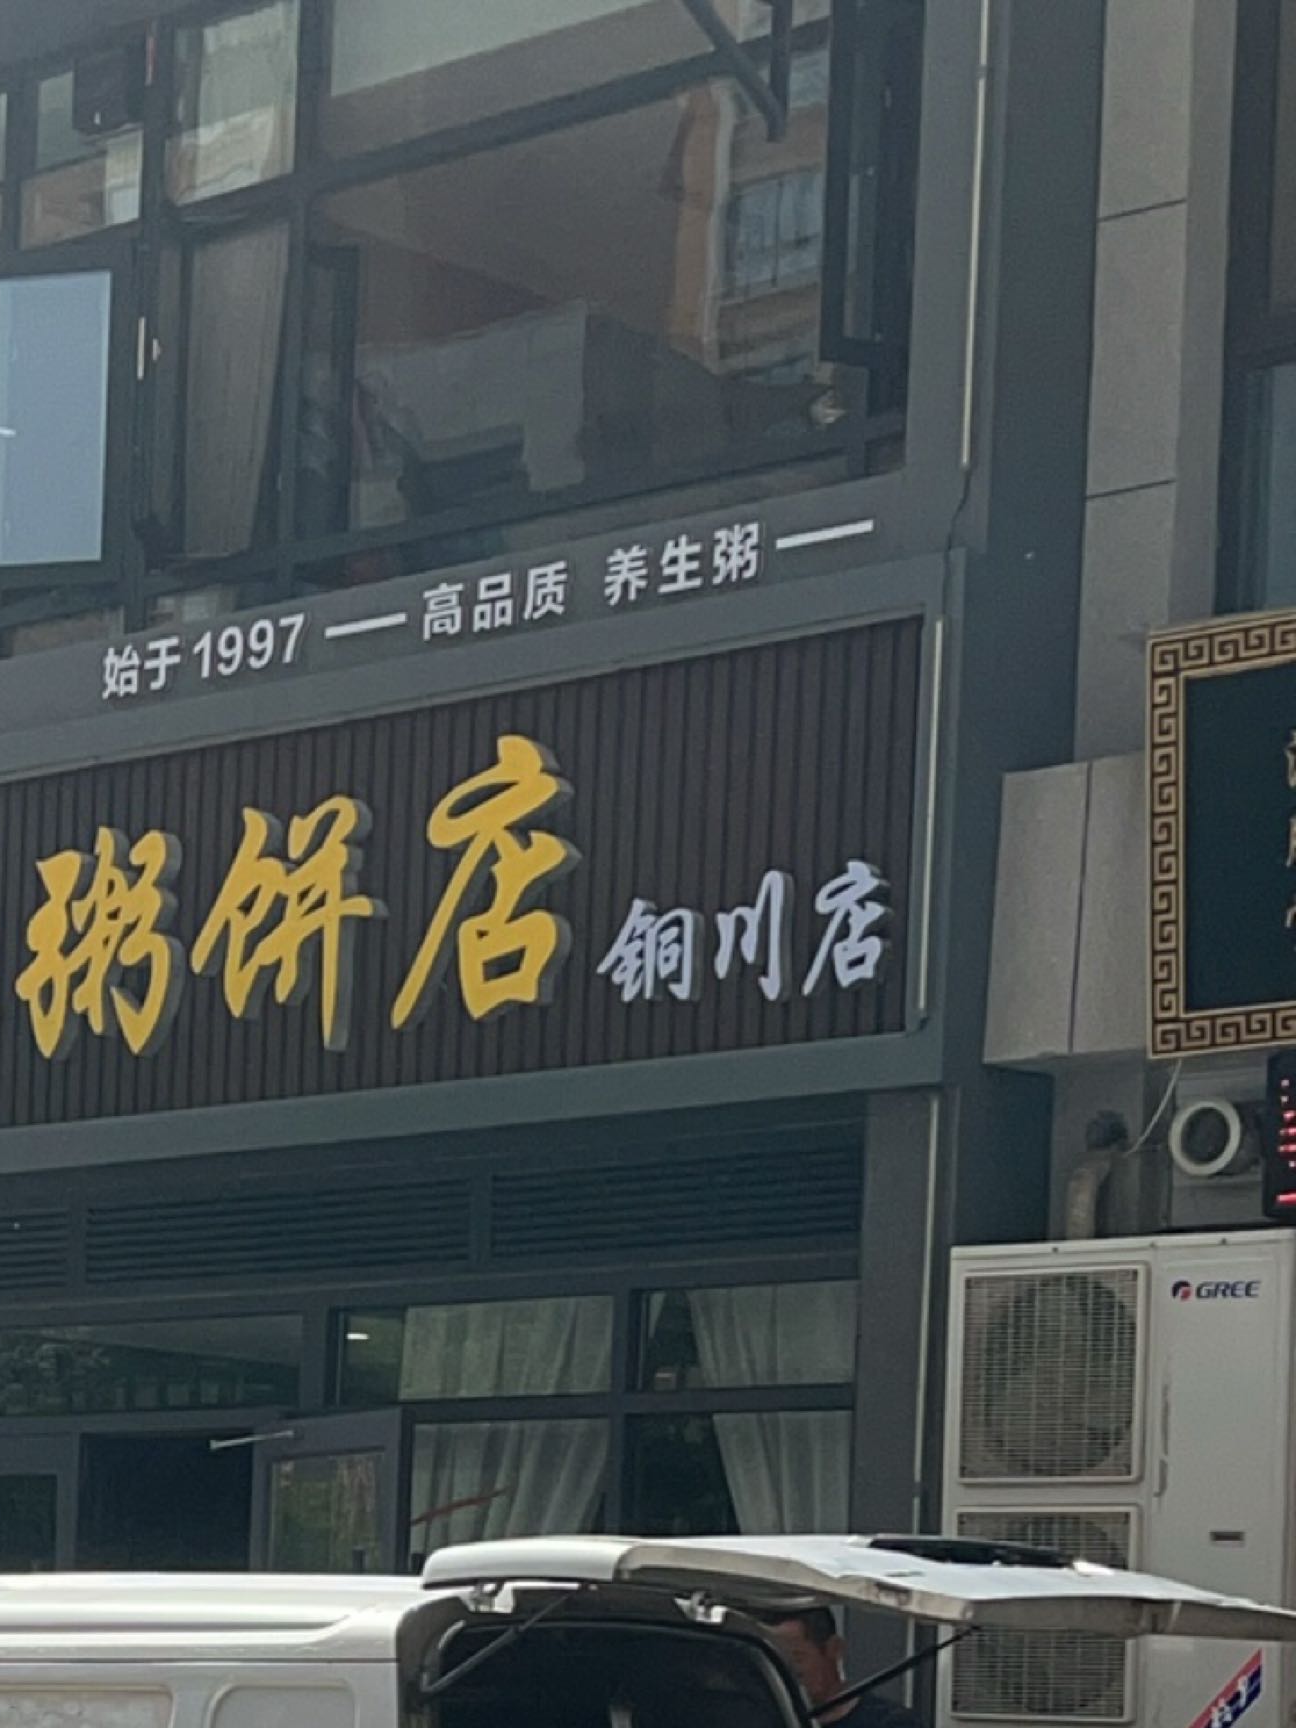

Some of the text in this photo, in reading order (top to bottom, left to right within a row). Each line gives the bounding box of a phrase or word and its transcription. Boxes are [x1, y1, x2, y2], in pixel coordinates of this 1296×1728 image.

[422, 559, 569, 642] 高品质
[603, 521, 760, 607] 养生粥
[597, 860, 886, 1004] 铜川店
[1195, 1280, 1262, 1300] GREE
